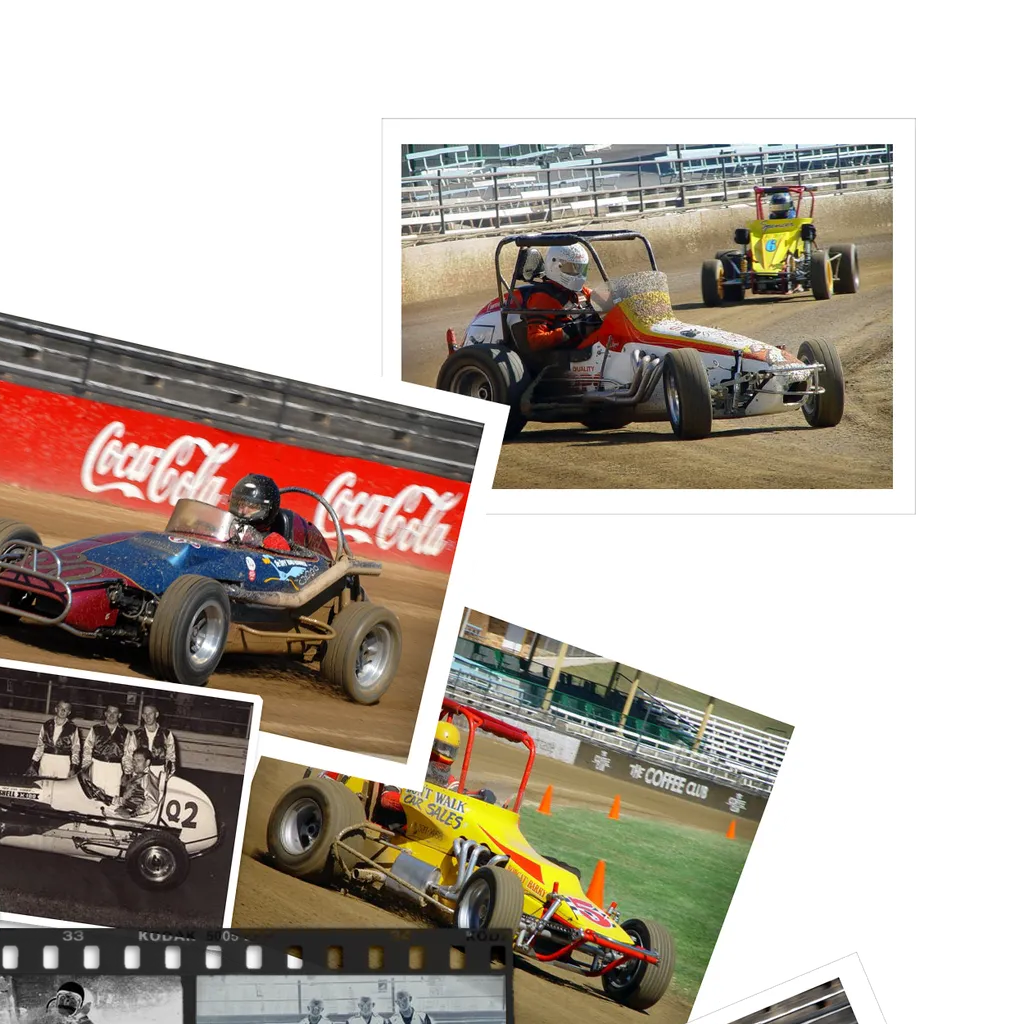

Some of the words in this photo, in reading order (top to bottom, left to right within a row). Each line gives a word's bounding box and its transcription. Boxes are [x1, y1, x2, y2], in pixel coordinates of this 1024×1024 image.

[765, 239, 777, 253] 6
[644, 767, 687, 794] COFFEE
[685, 781, 709, 799] CLUB
[166, 799, 198, 829] Q2
[404, 794, 423, 810] CAR
[426, 803, 464, 829] SALES
[436, 791, 468, 813] WALK
[138, 931, 196, 941] KODAK
